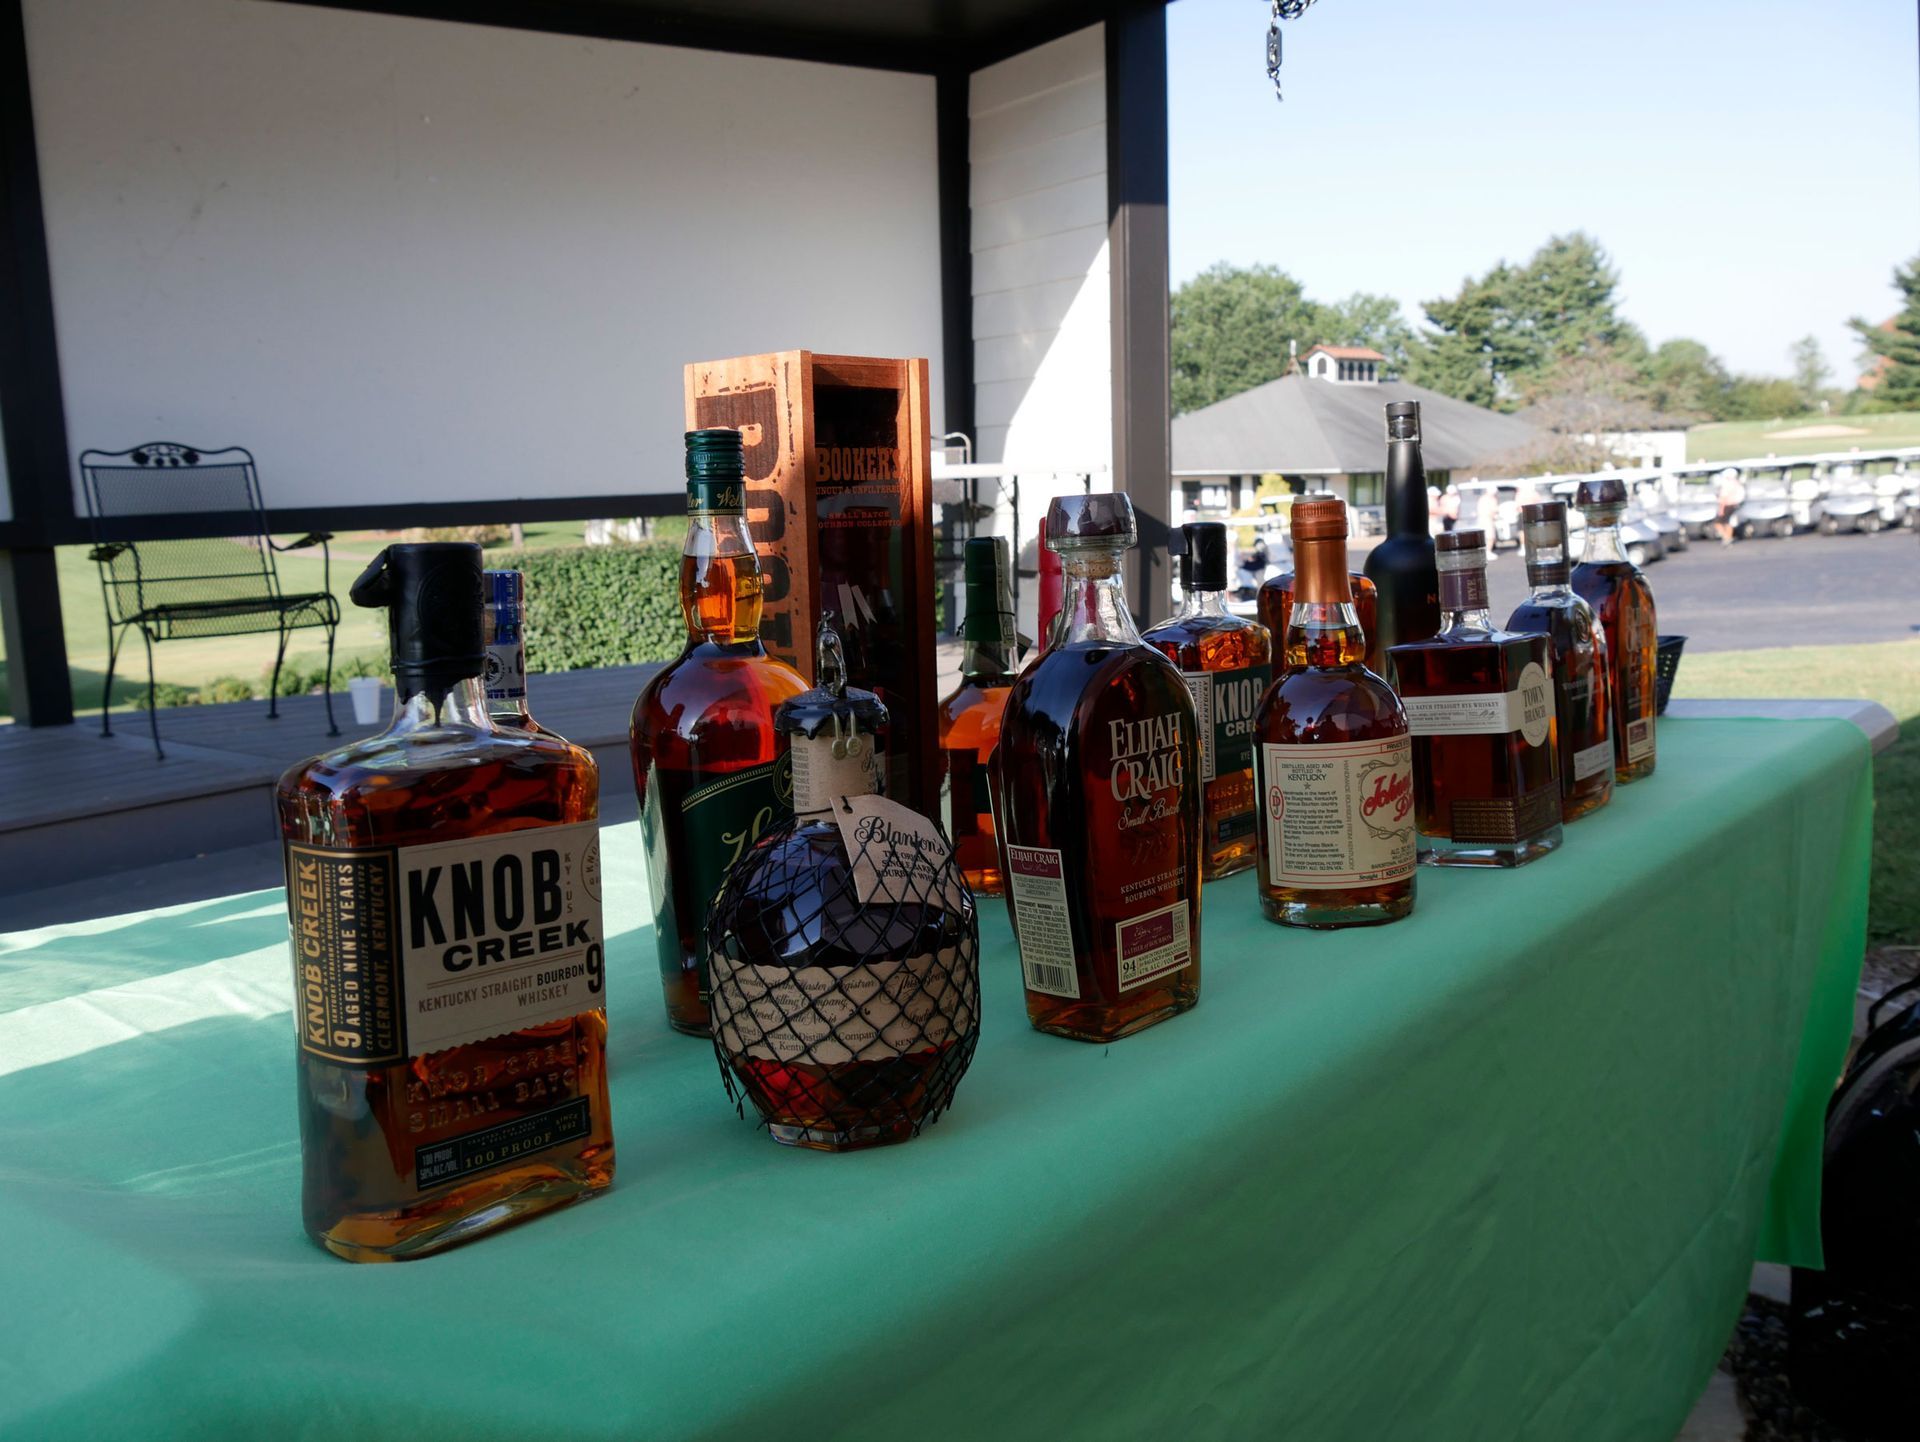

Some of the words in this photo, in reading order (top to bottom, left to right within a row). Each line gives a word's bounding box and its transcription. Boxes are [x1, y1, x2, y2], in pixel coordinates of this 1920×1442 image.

[818, 520, 855, 529] OURBON
[857, 519, 902, 529] COLLECTIO
[1523, 685, 1545, 708] TOWN
[1108, 711, 1183, 761] ELIJAH
[1110, 750, 1184, 802] CRAIG
[1288, 773, 1327, 781] KENTUCKY
[854, 815, 945, 856] Blanton's
[1118, 806, 1150, 831] Small
[1011, 848, 1032, 862] ELIJAH
[1034, 851, 1058, 865] CRAIG
[323, 863, 331, 900] WHISKEY
[338, 864, 355, 922] YEARS
[408, 849, 562, 949] KNOB
[1120, 877, 1156, 895] KENTUCKY
[1157, 865, 1187, 884] STRAIGHT
[1124, 887, 1157, 904] BOURBON
[1158, 876, 1185, 894] WHISKEY
[298, 858, 322, 958] CREEK
[326, 905, 334, 941] BOURBON
[367, 863, 388, 951] KENTUCKY
[341, 928, 357, 973] NINE
[443, 919, 591, 972] CREEK
[328, 949, 336, 985] STRAIGHT
[1123, 961, 1136, 975] 94
[304, 964, 328, 1046] KNOB
[330, 985, 338, 1024] KENTUCKY
[344, 980, 361, 1027] AGED
[372, 959, 392, 1049] CLERMONT,
[418, 986, 478, 1013] KENTUCKY
[481, 975, 533, 1000] STRAIGHT
[537, 963, 585, 987] BOURBON
[518, 983, 569, 1007] WHISKEY
[333, 1029, 362, 1048] 9
[407, 1064, 489, 1104] KNOB
[409, 1091, 500, 1133] SMALL
[465, 1150, 495, 1169] 100
[501, 1132, 552, 1157] PROOF
